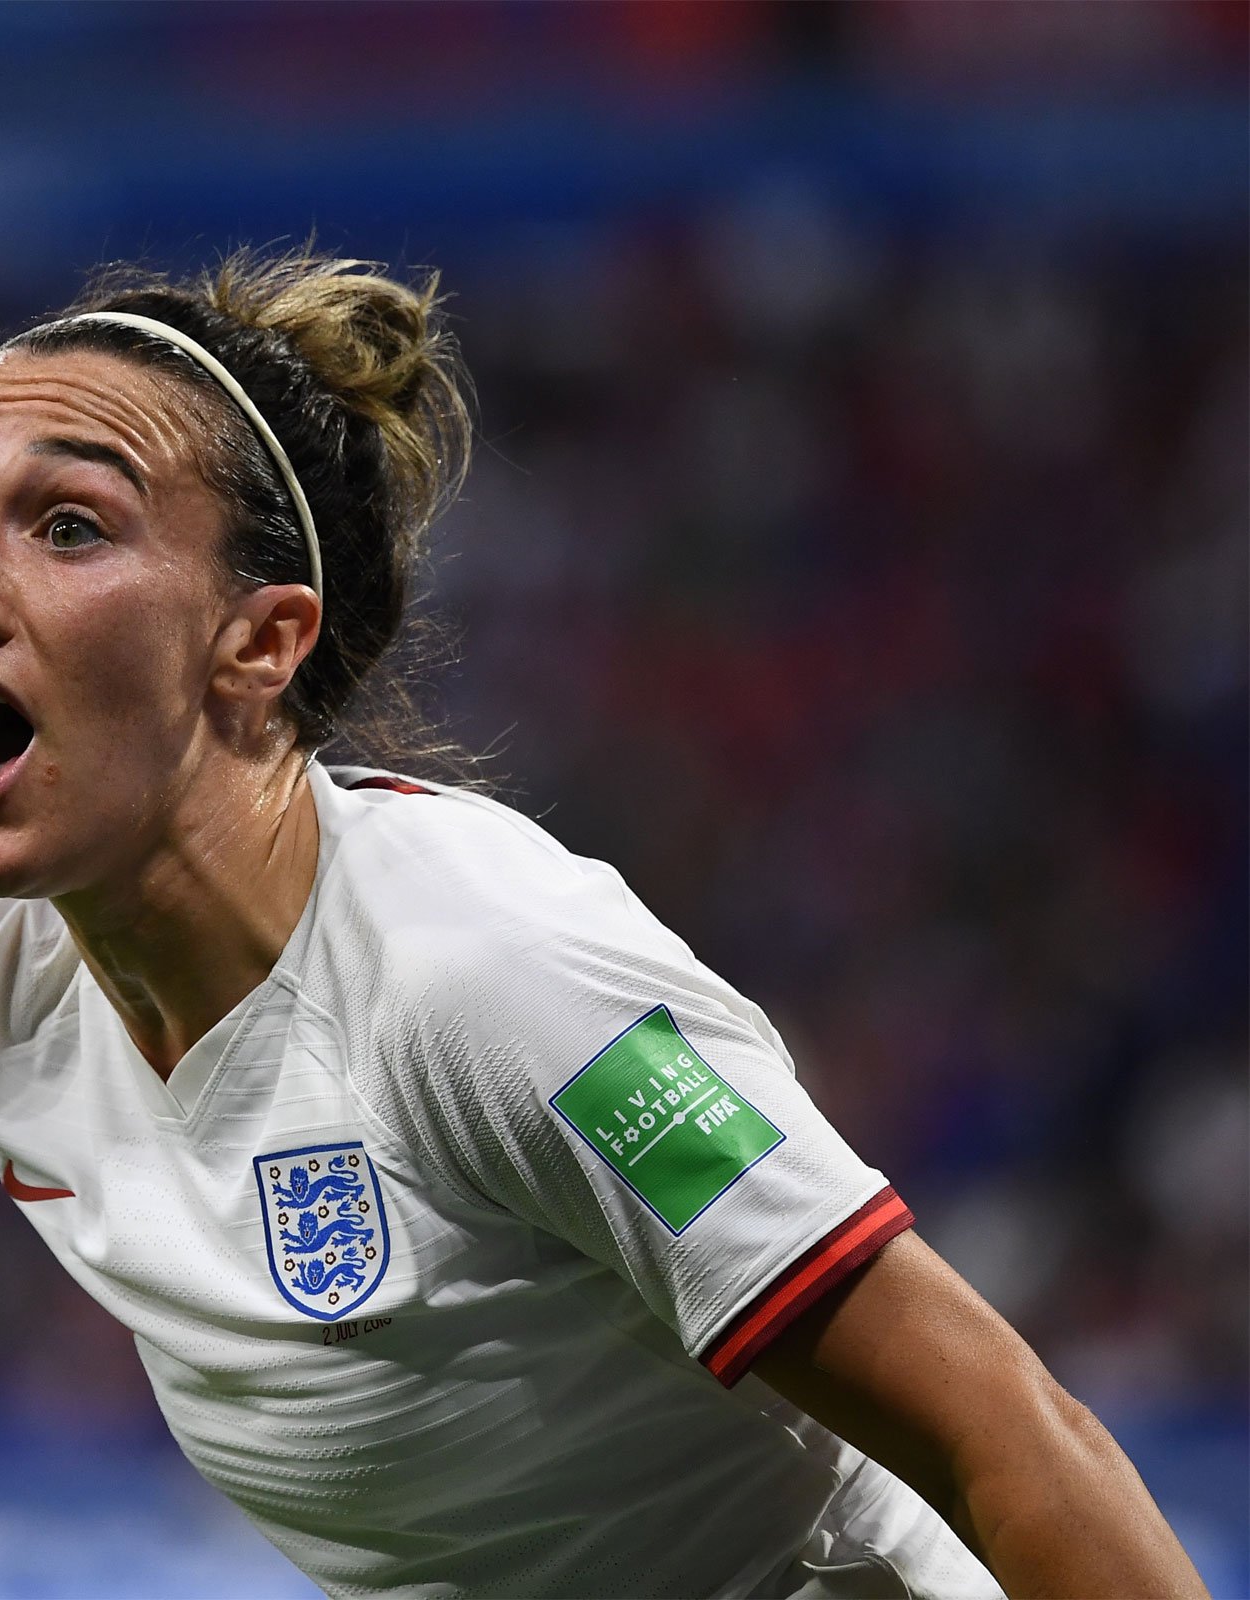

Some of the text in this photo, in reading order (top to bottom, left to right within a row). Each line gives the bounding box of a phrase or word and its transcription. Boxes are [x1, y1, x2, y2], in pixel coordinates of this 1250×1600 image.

[596, 1053, 693, 1141] LIVING
[610, 1071, 708, 1156] FOOTBALL
[322, 1326, 332, 1346] 2
[335, 1322, 358, 1342] JULY
